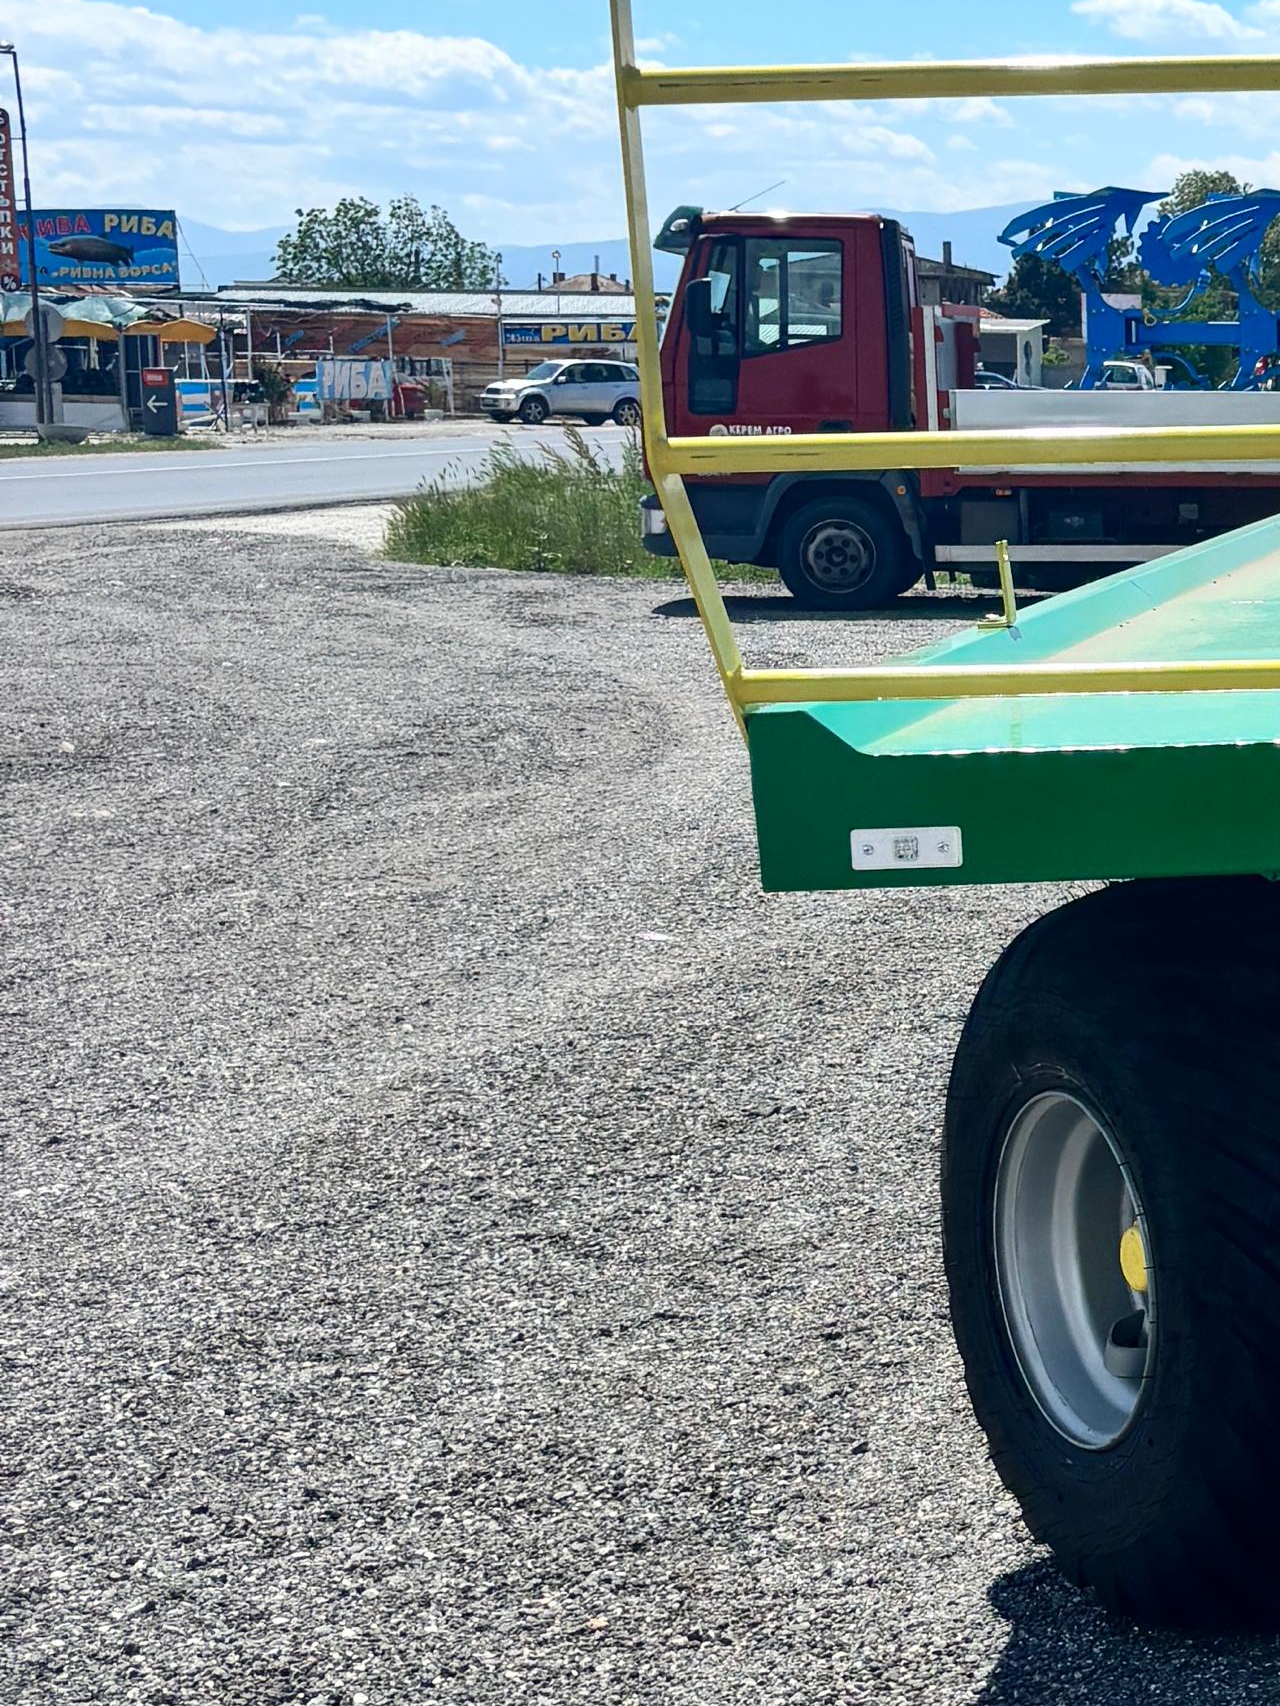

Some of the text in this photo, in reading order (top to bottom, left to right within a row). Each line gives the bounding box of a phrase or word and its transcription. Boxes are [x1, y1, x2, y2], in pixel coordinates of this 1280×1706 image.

[104, 213, 174, 239] РИБА
[322, 361, 387, 398] РИБА
[729, 425, 792, 435] КЕРЕМ АГРО
